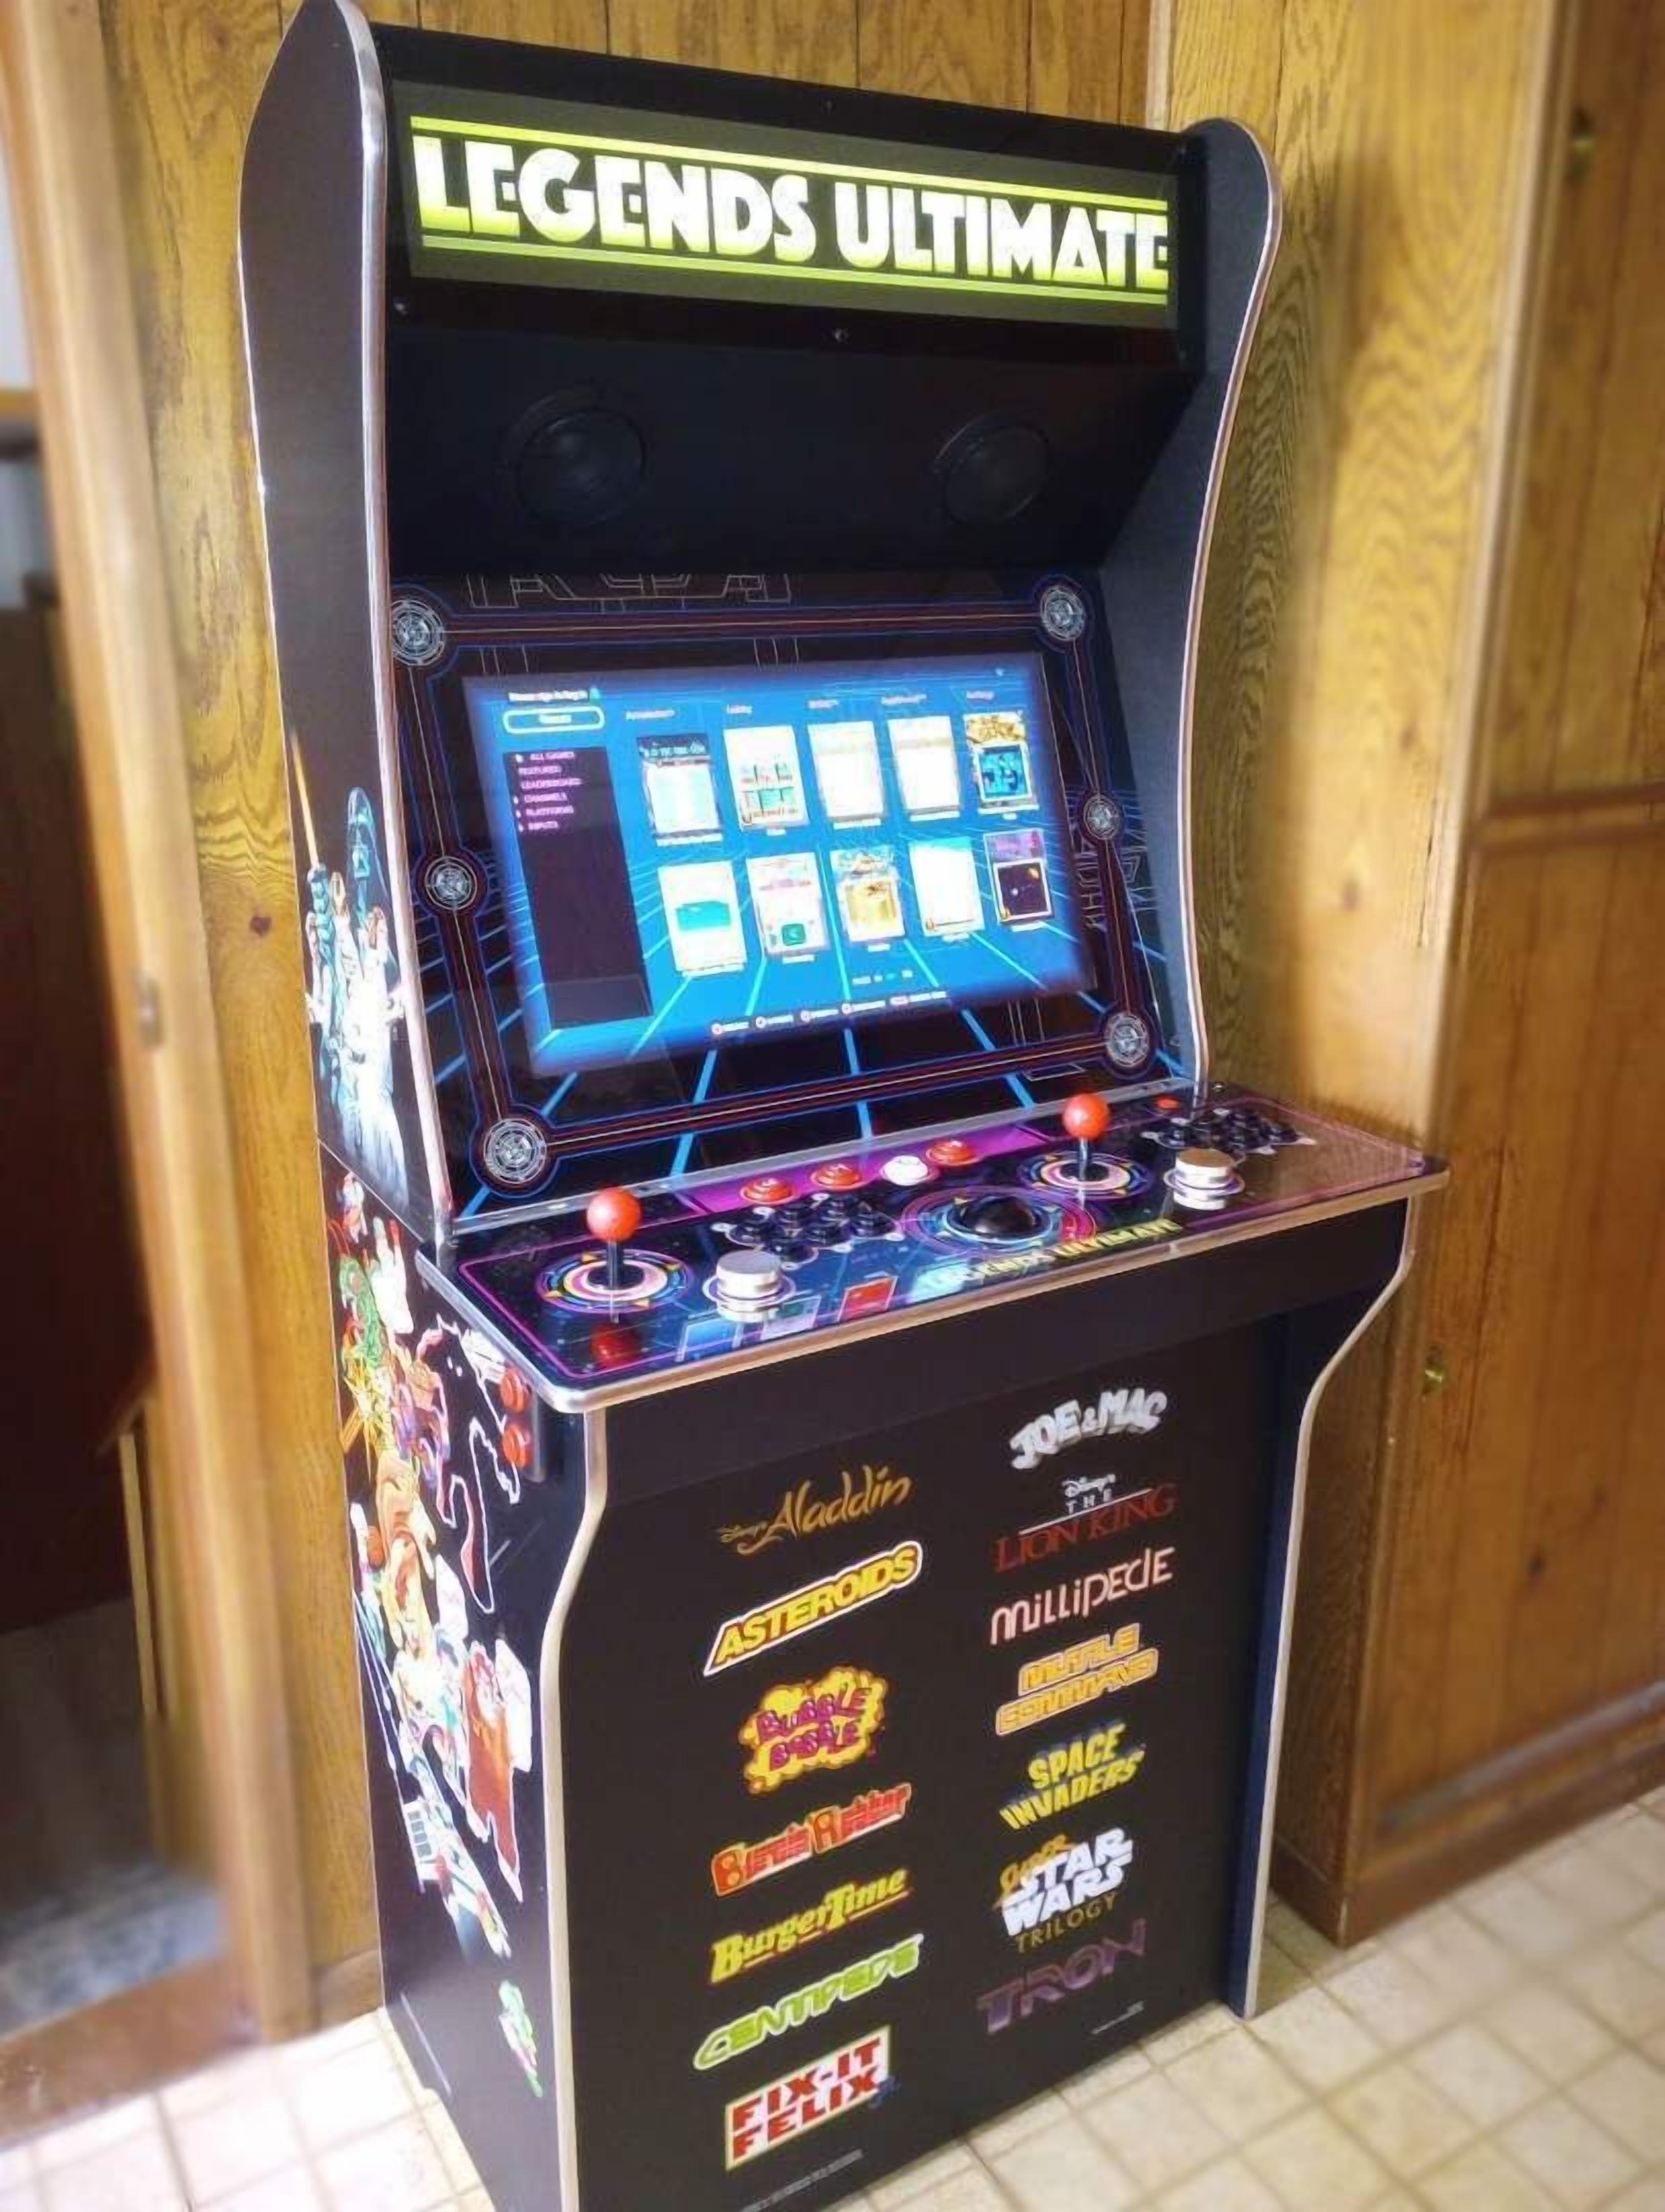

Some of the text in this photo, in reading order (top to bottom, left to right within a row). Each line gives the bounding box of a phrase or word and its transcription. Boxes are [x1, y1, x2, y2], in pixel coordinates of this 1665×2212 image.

[412, 135, 1168, 289] LEGENDS ULTIMATE
[1010, 1399, 1082, 1470] JOE
[1096, 1388, 1168, 1436] MAC
[737, 1464, 913, 1556] Aladdin
[992, 1522, 1081, 1573] LION
[1090, 1483, 1177, 1541] KING
[713, 1545, 920, 1665] ASTEROIDS
[999, 1749, 1146, 1830] INVADERS
[1028, 1721, 1126, 1789] SPACE
[1002, 1827, 1133, 1909] STAR
[1002, 1852, 1133, 1936] WARS
[1015, 1892, 1118, 1953] TRILOGY
[976, 1917, 1147, 2034] TRON
[733, 2037, 881, 2133] FIX-IT
[733, 2066, 878, 2160] FELIX
